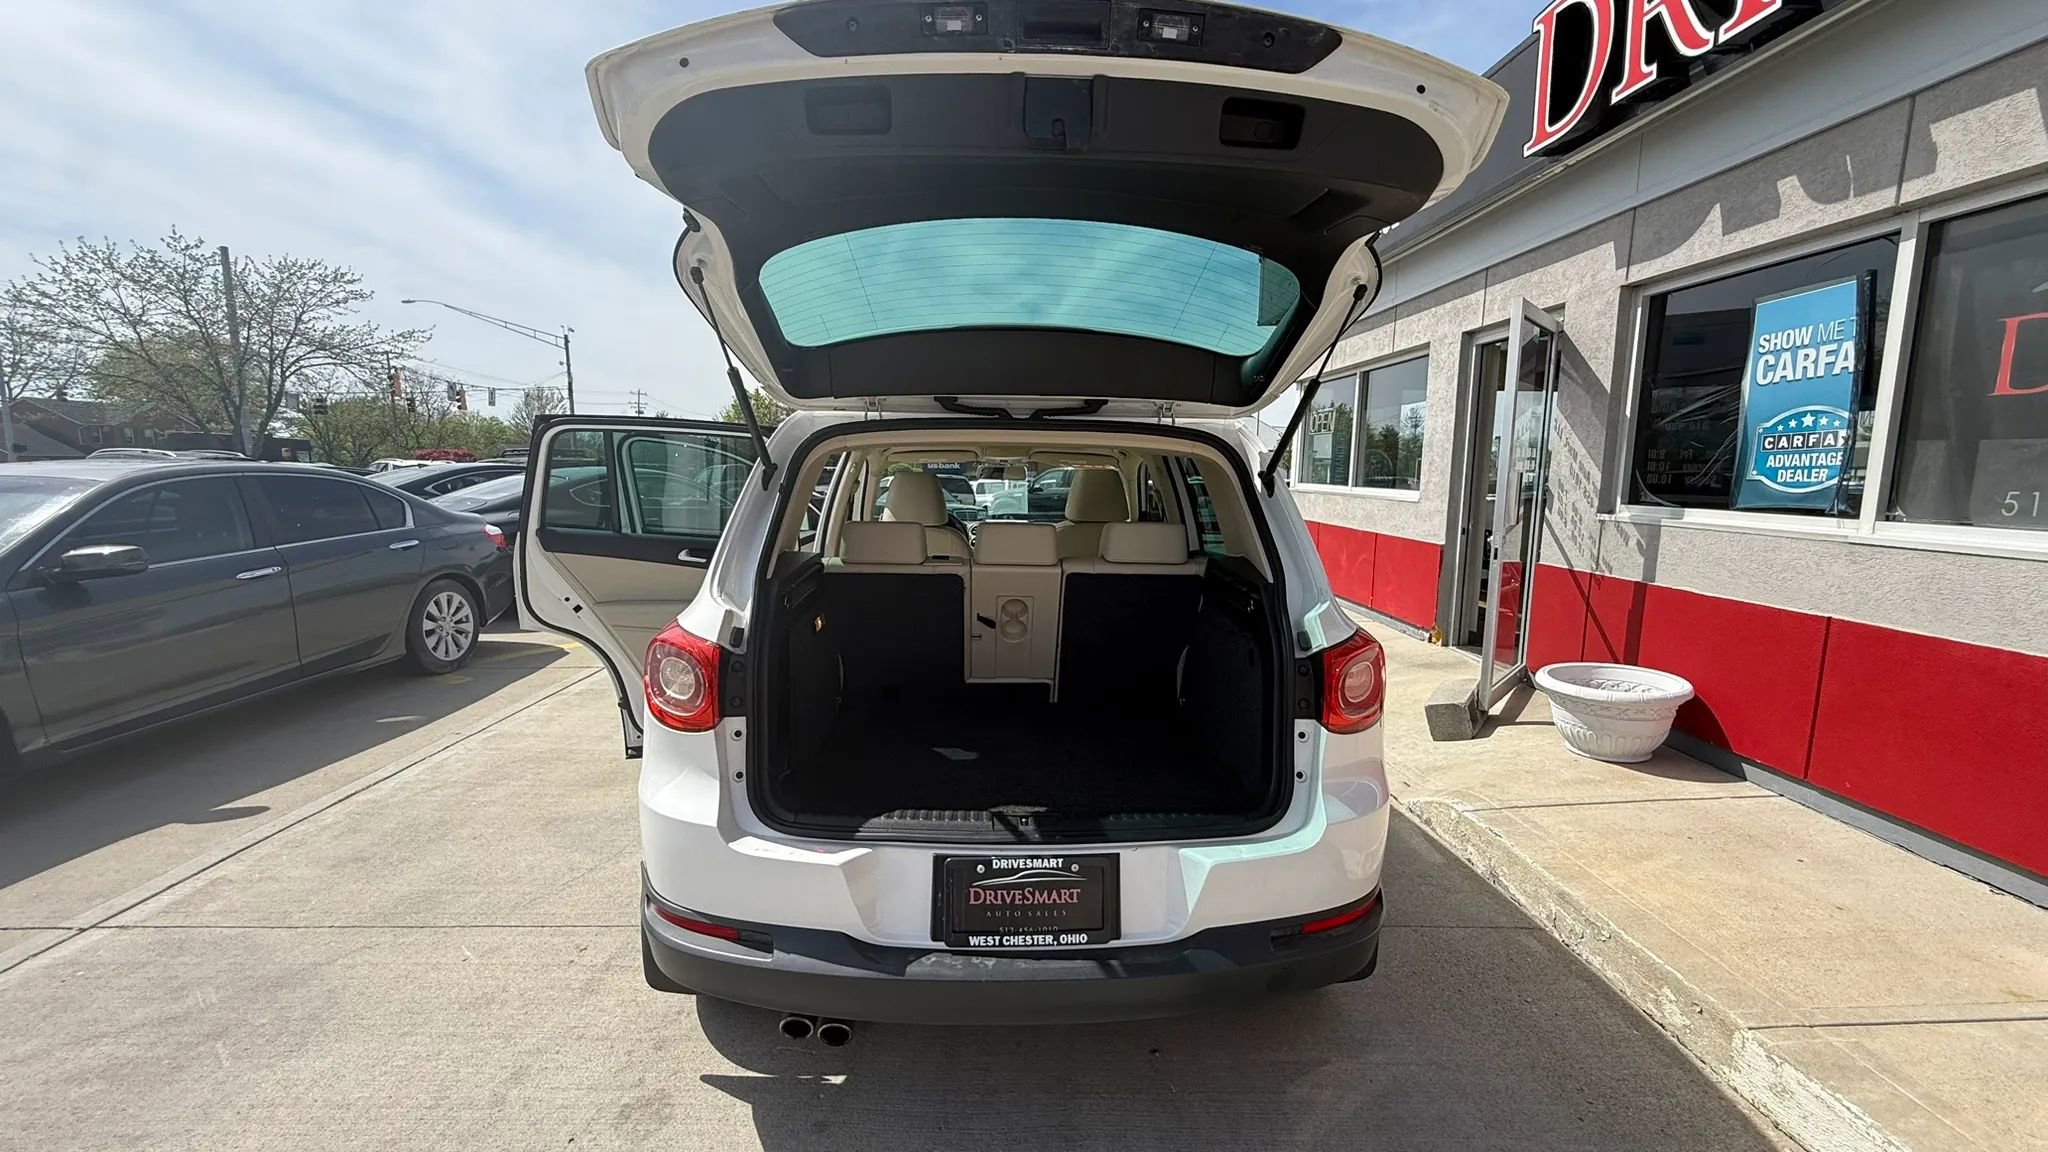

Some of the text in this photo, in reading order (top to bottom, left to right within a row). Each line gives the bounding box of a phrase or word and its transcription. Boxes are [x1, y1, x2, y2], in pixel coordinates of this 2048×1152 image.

[1522, 0, 1783, 158] DR
[1758, 325, 1814, 353] SHOW
[1817, 318, 1846, 343] ME
[1311, 410, 1334, 433] OPEN
[1766, 452, 1844, 468] ADVANTAGE
[1776, 468, 1829, 483] DEALER
[992, 858, 1064, 869] DRIVESMART
[969, 888, 1081, 905] DRIVESMART
[968, 933, 1089, 946] WEST CHESTER, OHIO
